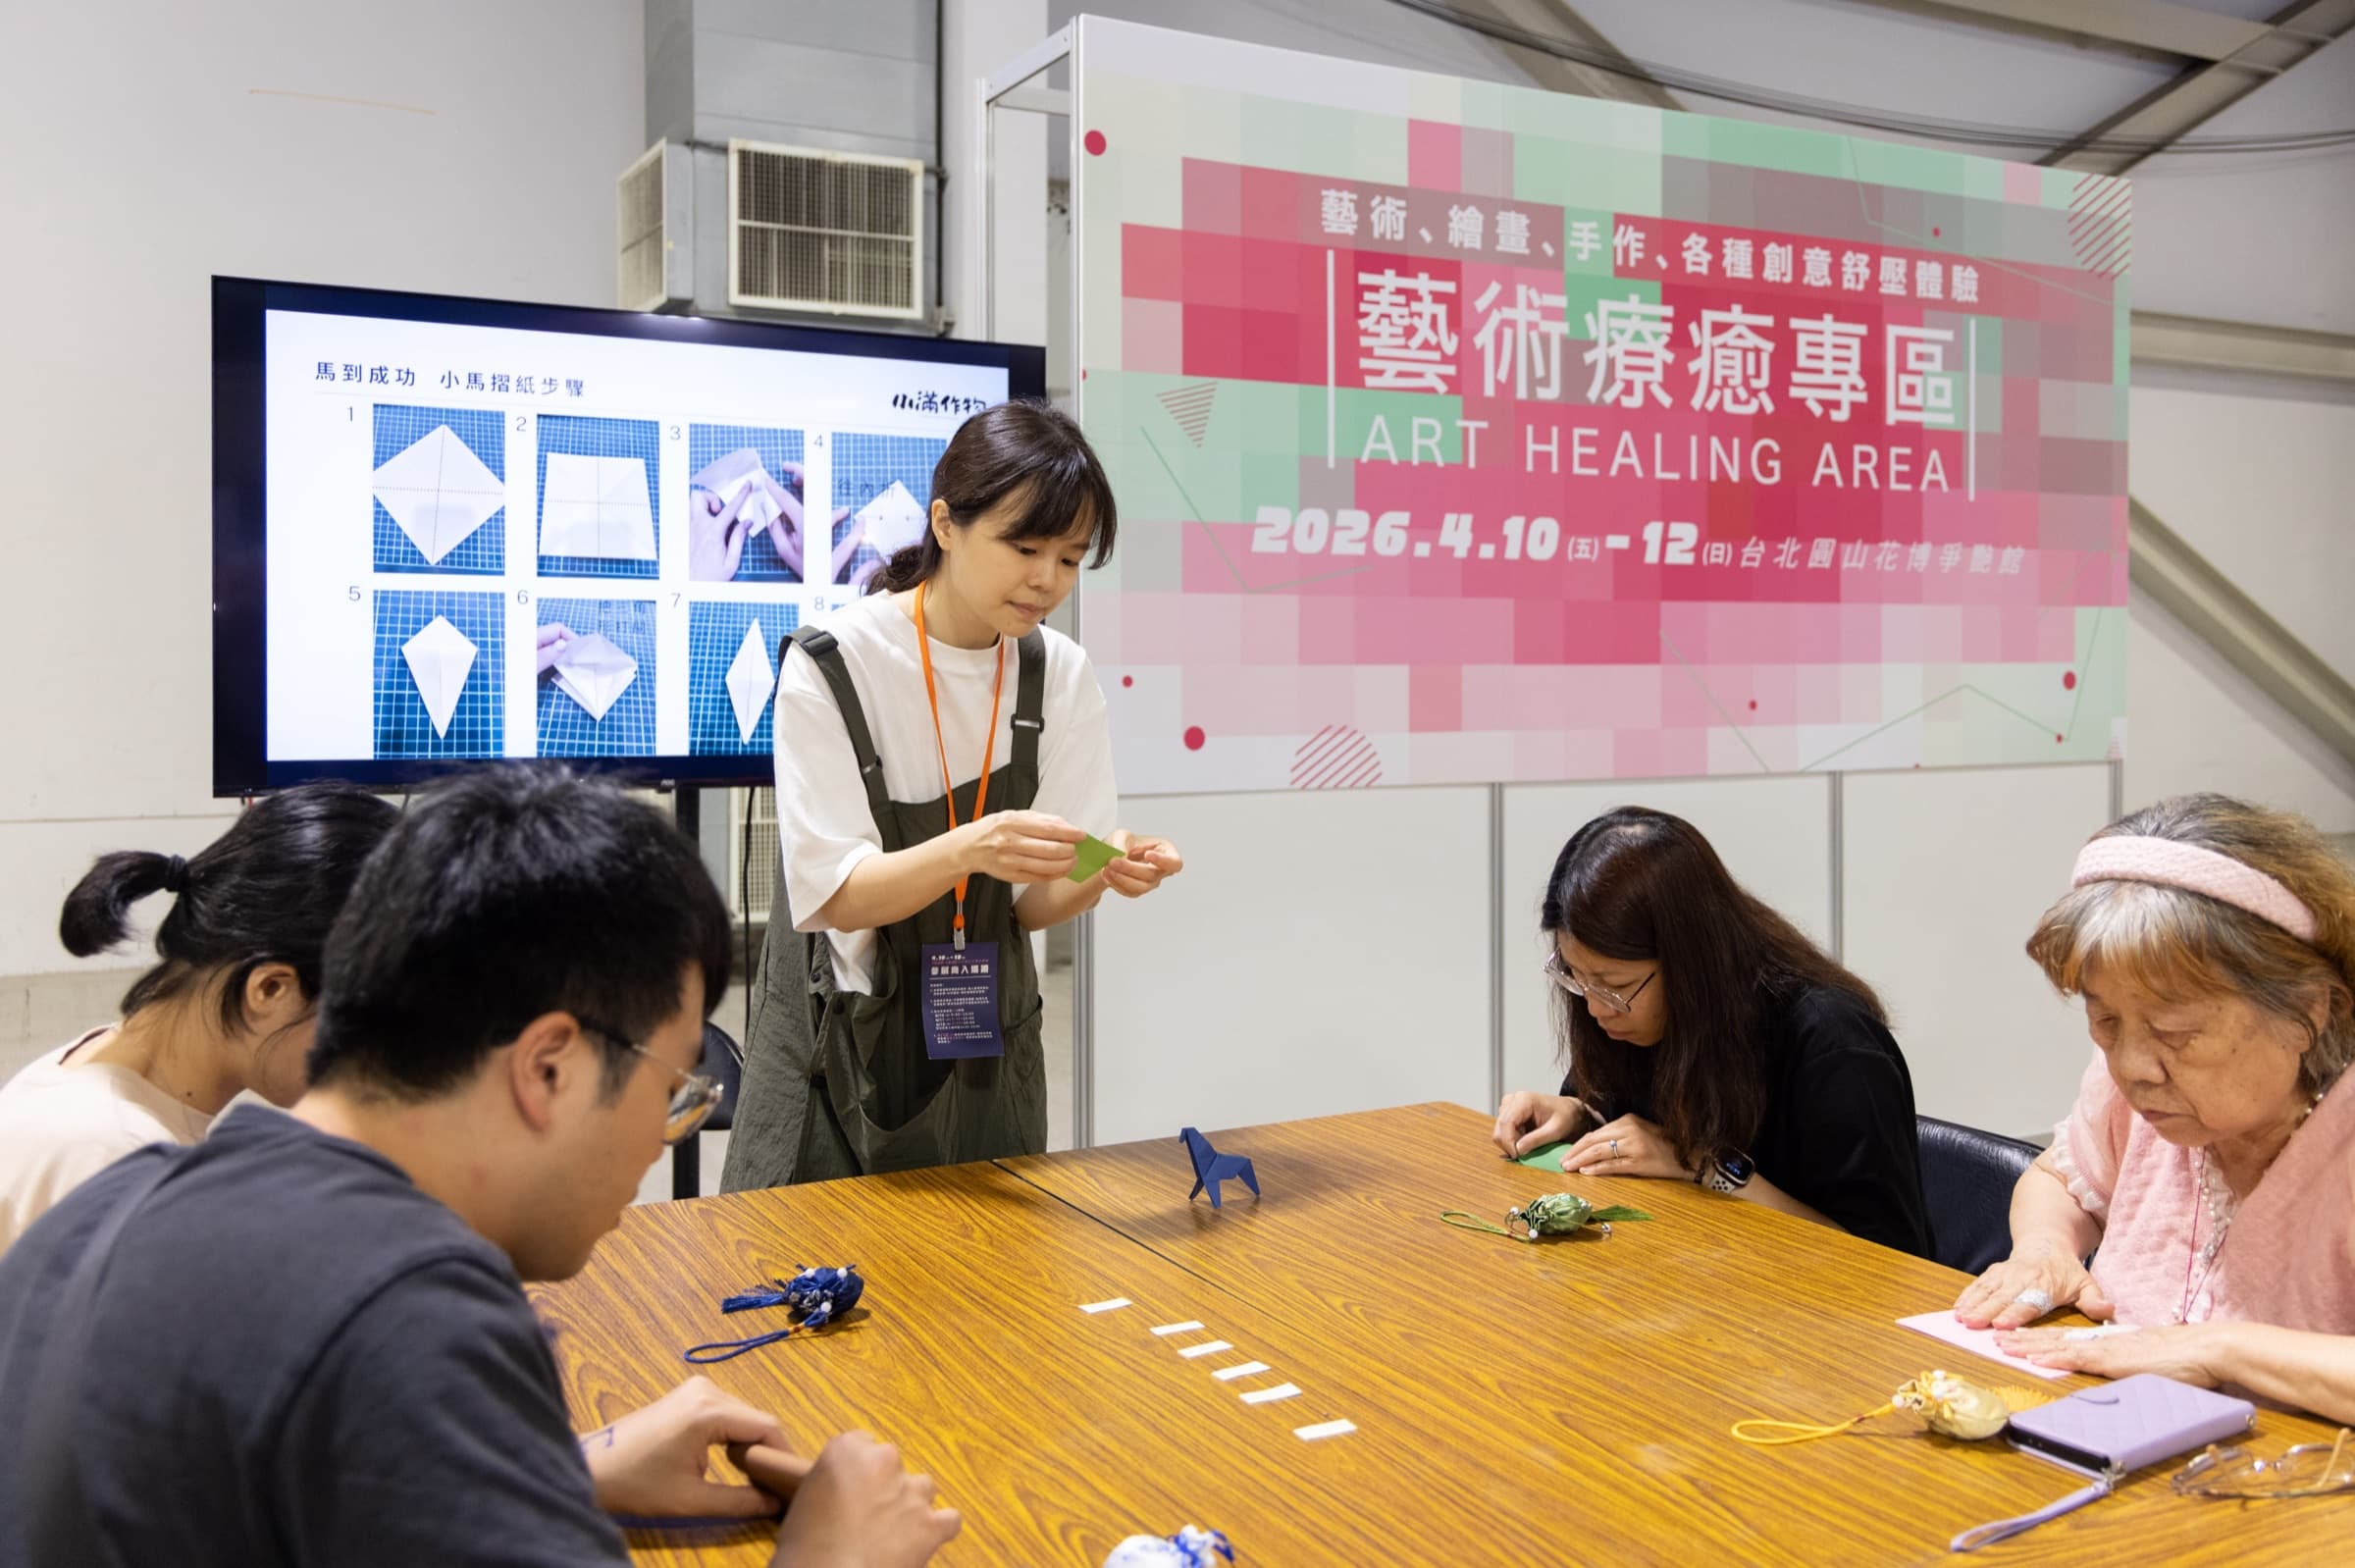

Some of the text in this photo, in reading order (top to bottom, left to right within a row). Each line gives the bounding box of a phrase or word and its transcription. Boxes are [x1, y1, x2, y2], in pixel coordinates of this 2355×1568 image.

[1321, 188, 1979, 304] 藝術、繪畫、手作、各種創意舒壓體驗
[1357, 268, 1956, 426] 藝術療癒專區
[315, 361, 416, 388] 馬到成功
[347, 406, 354, 422] 1
[515, 416, 528, 433] 2
[669, 425, 682, 442] 3
[813, 434, 825, 448] 4
[1360, 414, 1950, 494] ART HEALING AREA
[347, 586, 362, 602] 5
[516, 589, 530, 606] 6
[670, 594, 682, 608] 7
[813, 595, 825, 611] 8
